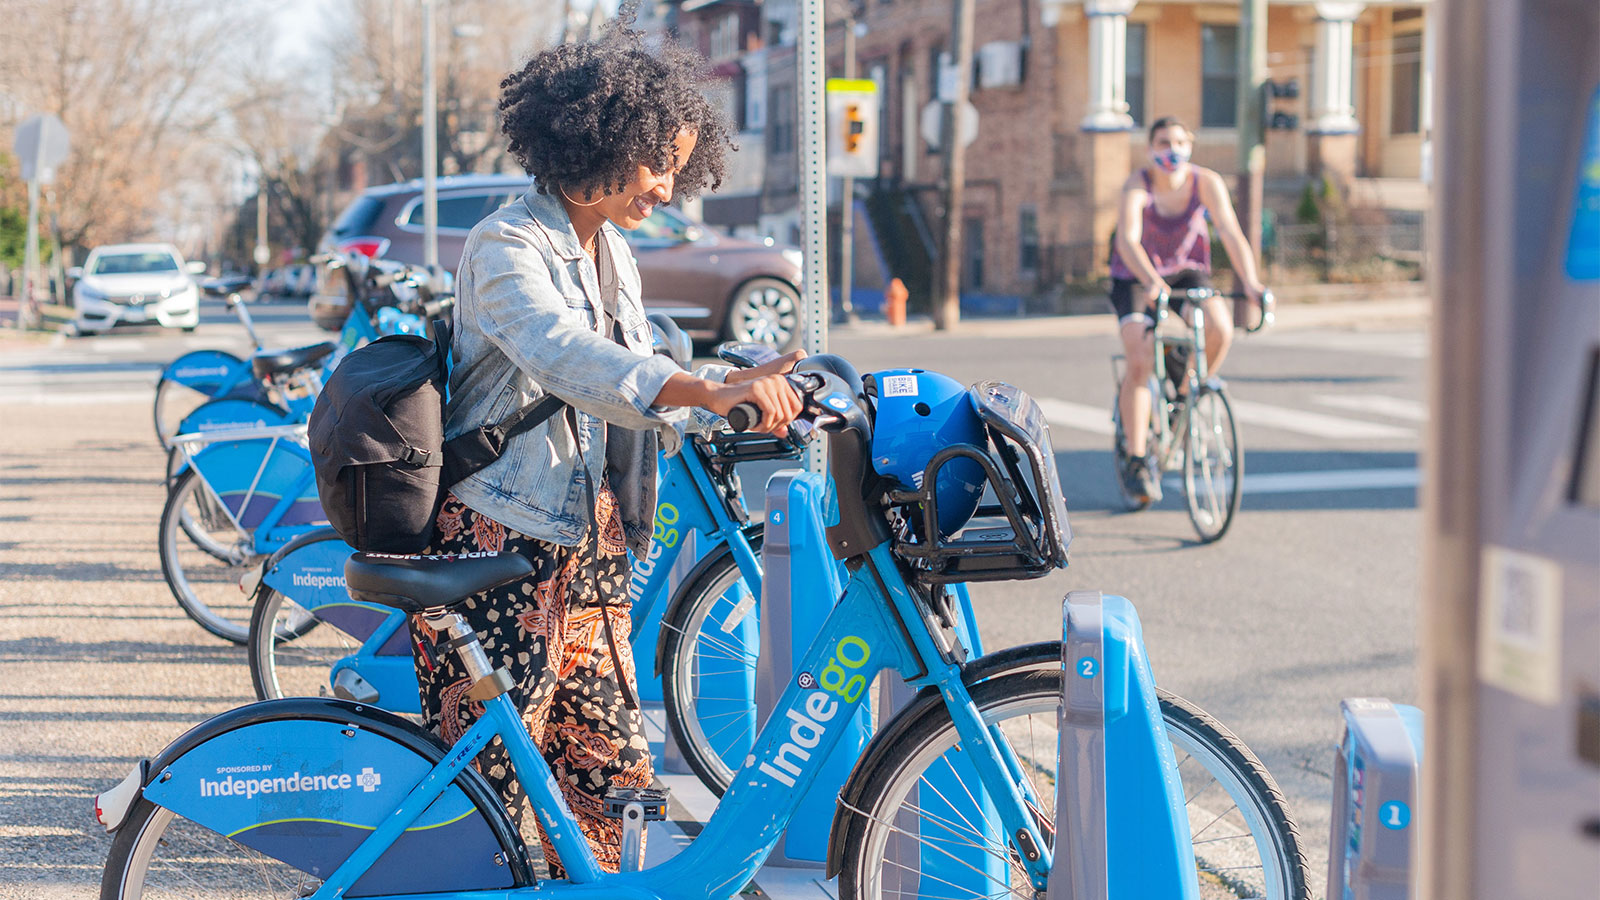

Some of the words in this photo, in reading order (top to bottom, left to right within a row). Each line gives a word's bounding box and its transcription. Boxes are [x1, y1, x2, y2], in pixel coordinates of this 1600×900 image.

[898, 377, 908, 393] BIKE
[773, 512, 781, 523] 4
[1082, 660, 1094, 676] 2
[758, 635, 871, 789] Indego
[447, 732, 483, 768] TREK
[216, 765, 261, 774] SPONSORED
[262, 764, 272, 772] BY
[200, 771, 352, 800] Independence
[1388, 804, 1402, 826] 1
